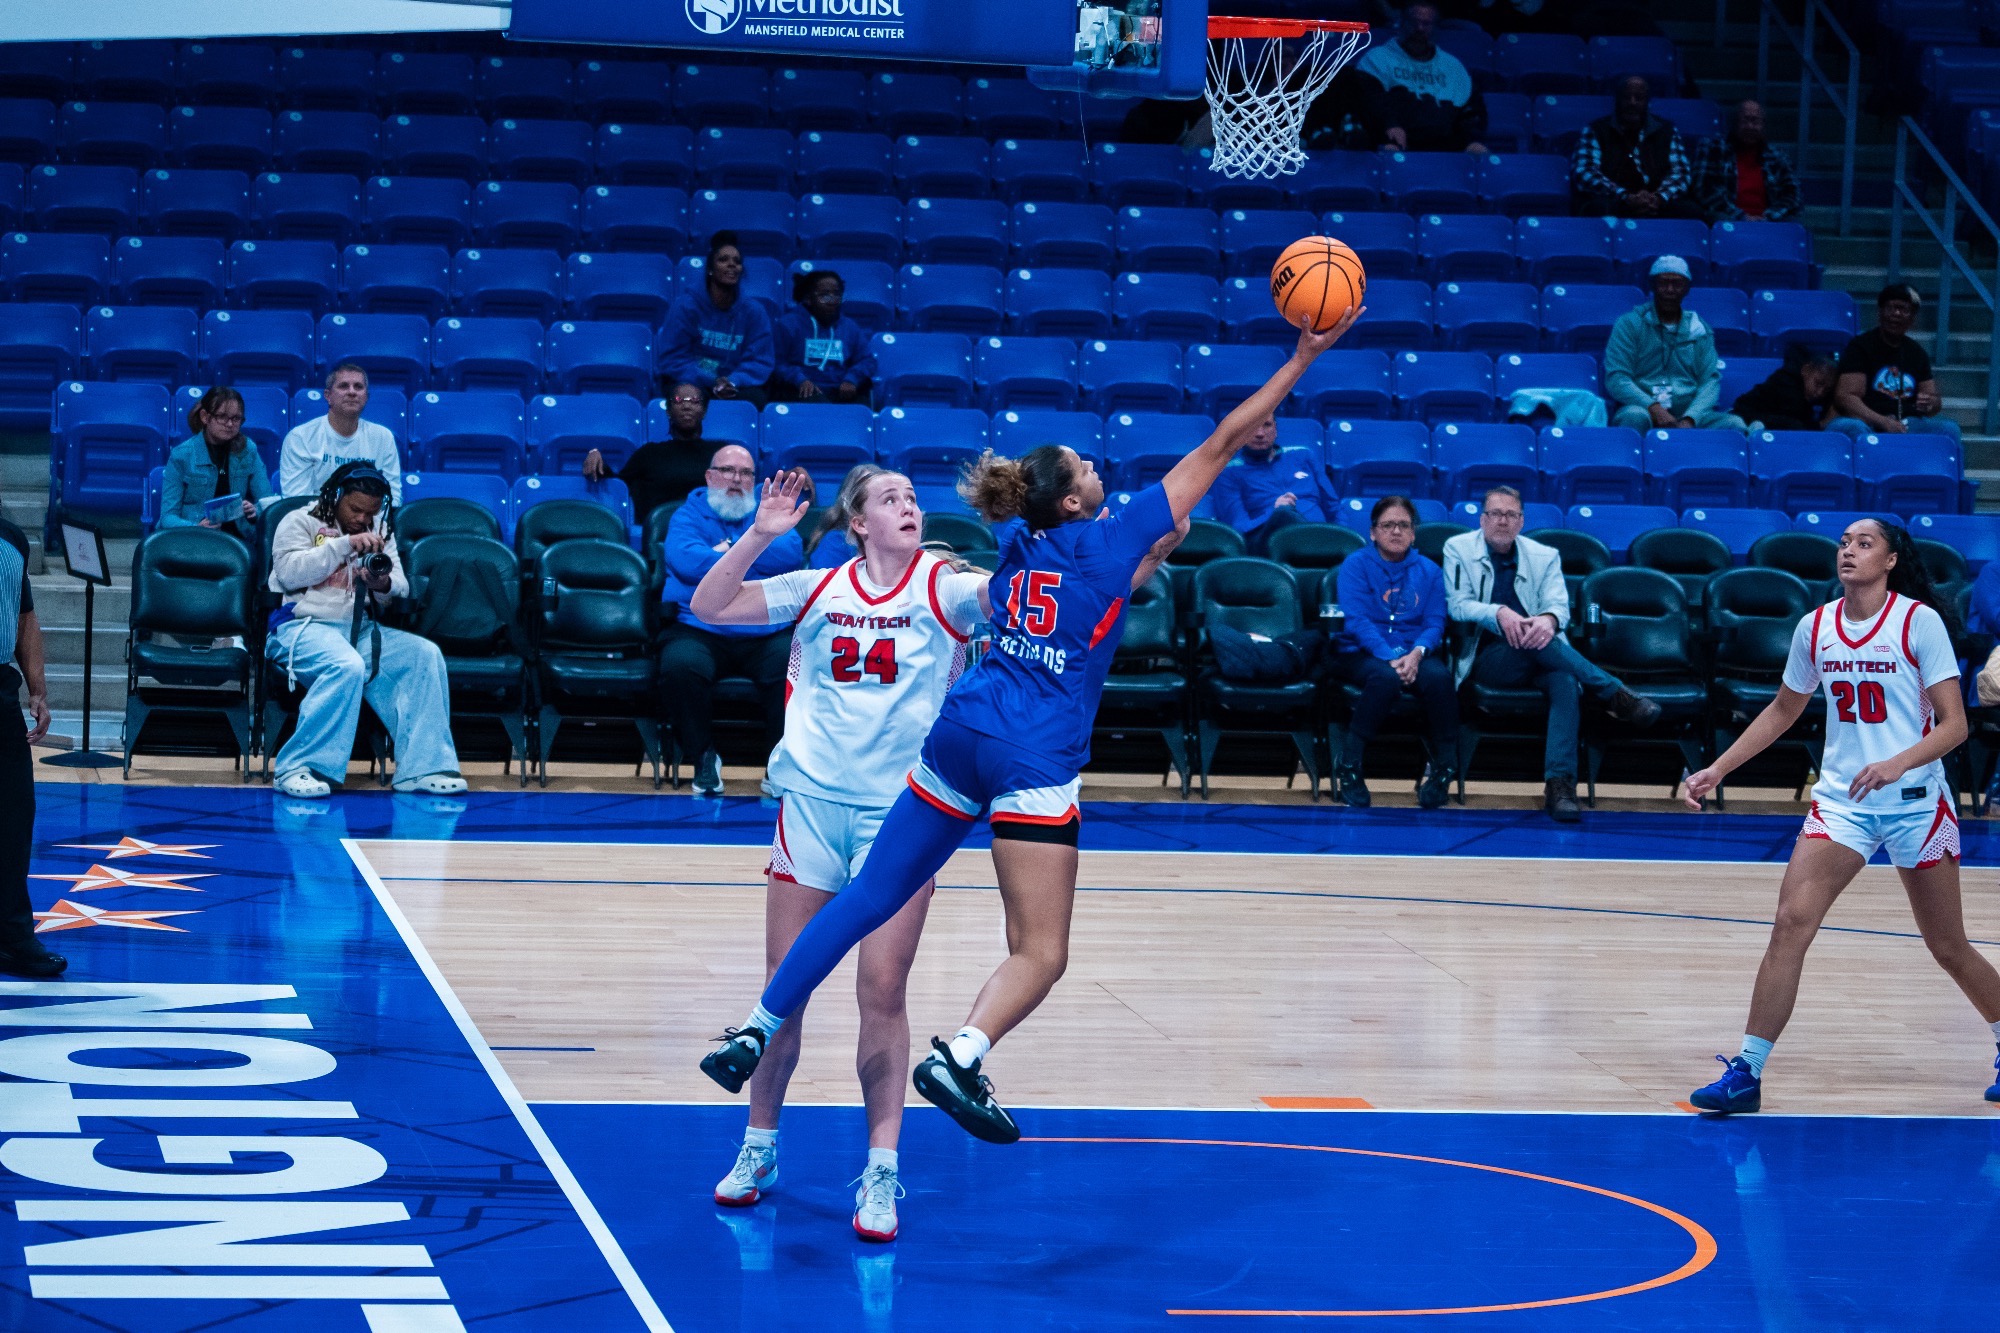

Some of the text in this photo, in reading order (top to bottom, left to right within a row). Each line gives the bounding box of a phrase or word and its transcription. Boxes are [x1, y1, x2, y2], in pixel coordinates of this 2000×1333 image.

[744, 24, 905, 39] MANSFIELD MEDICAL CENTER
[825, 612, 911, 629] UTAH TECH
[1006, 569, 1063, 638] 15
[831, 635, 899, 685] 24
[1822, 660, 1897, 674] UTAH TECH
[1830, 680, 1889, 725] 20
[0, 982, 451, 1333] INGTON
